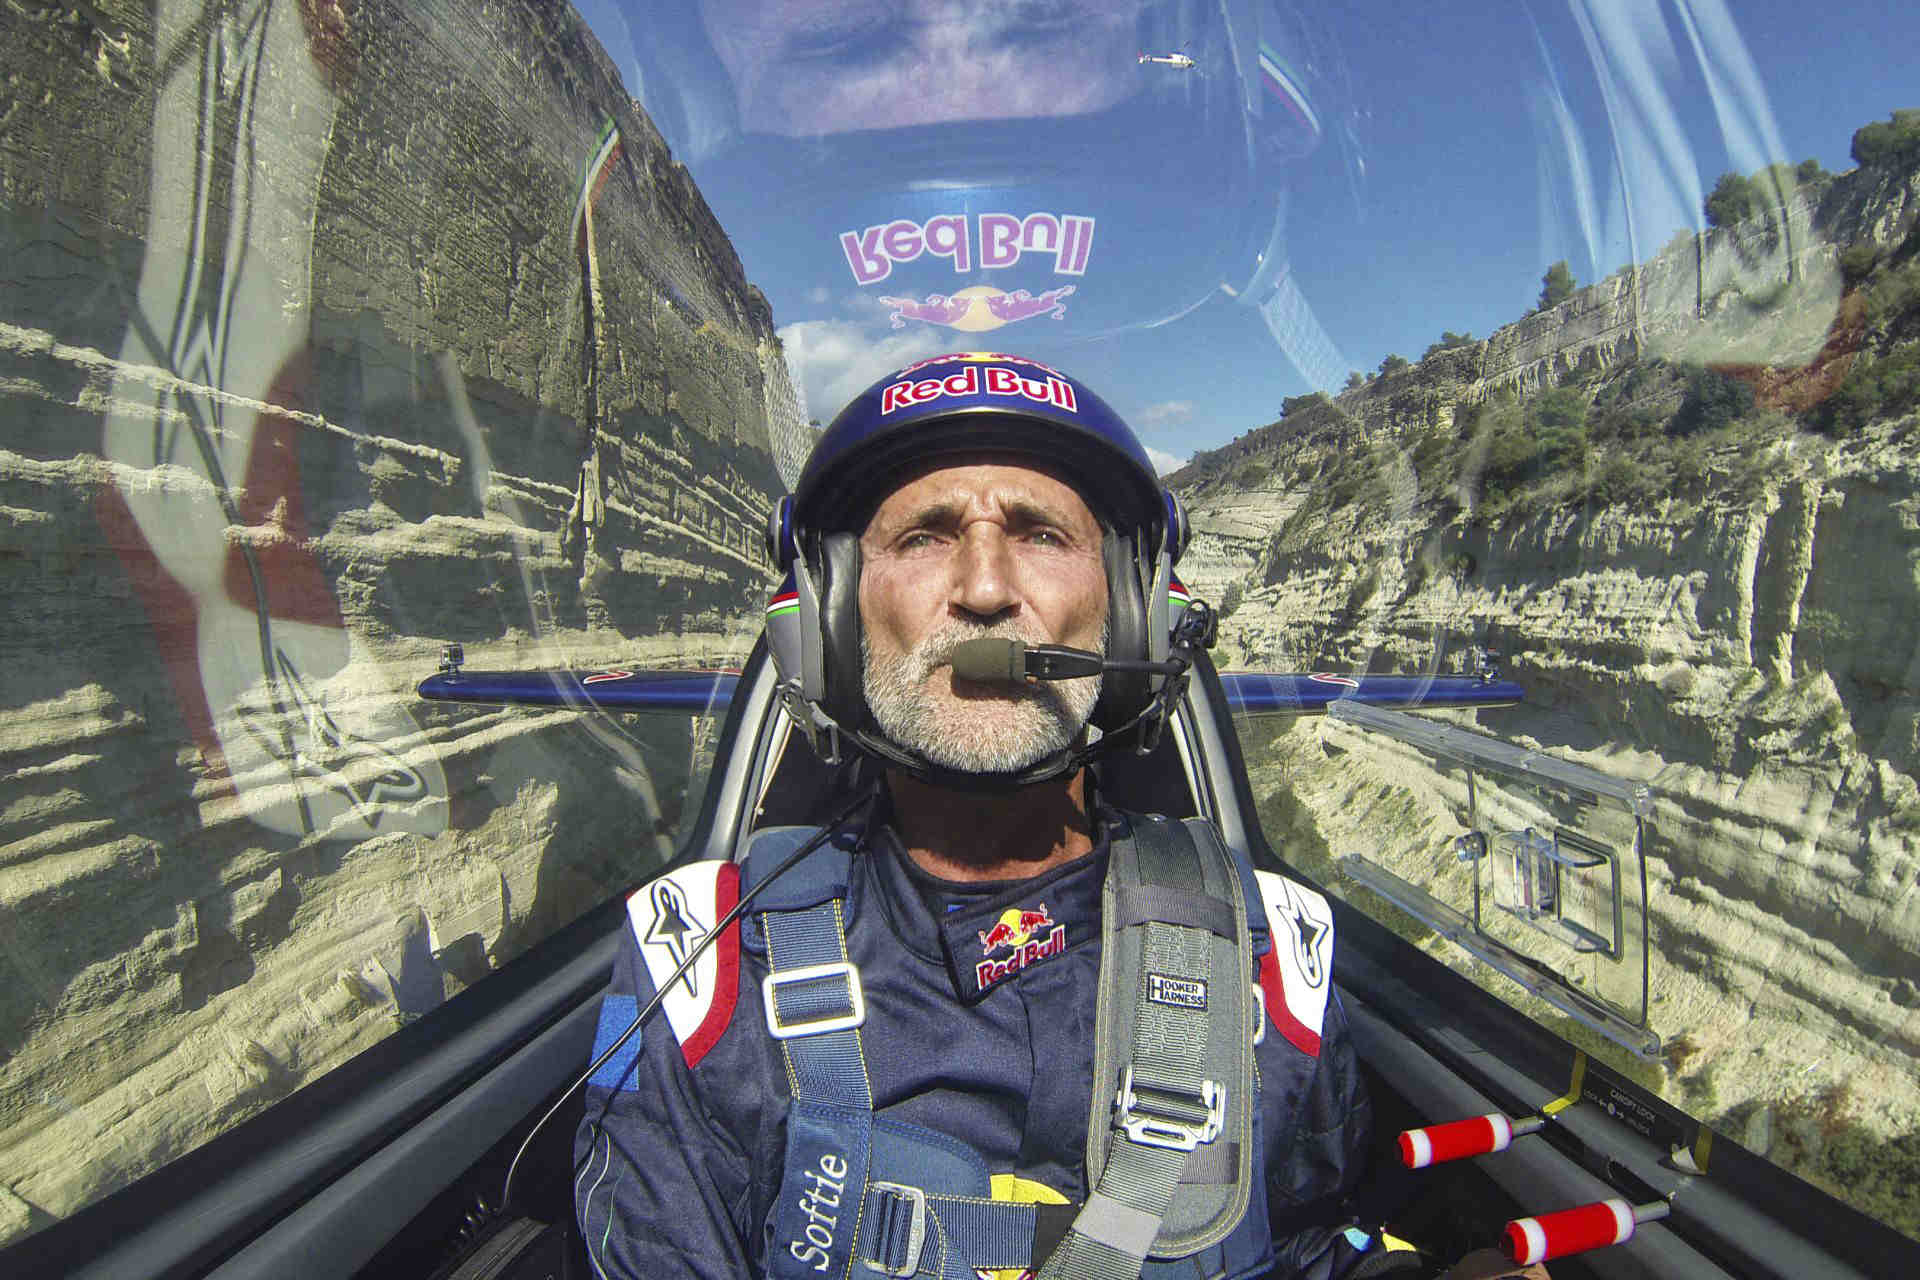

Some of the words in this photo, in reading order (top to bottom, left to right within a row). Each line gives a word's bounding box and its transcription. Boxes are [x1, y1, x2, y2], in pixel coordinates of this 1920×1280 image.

[881, 366, 978, 416] Red
[984, 367, 1078, 414] Bull
[976, 945, 1022, 990] Red
[1021, 924, 1066, 968] Bull
[1151, 977, 1199, 995] HOOKER
[790, 1154, 847, 1272] Softie
